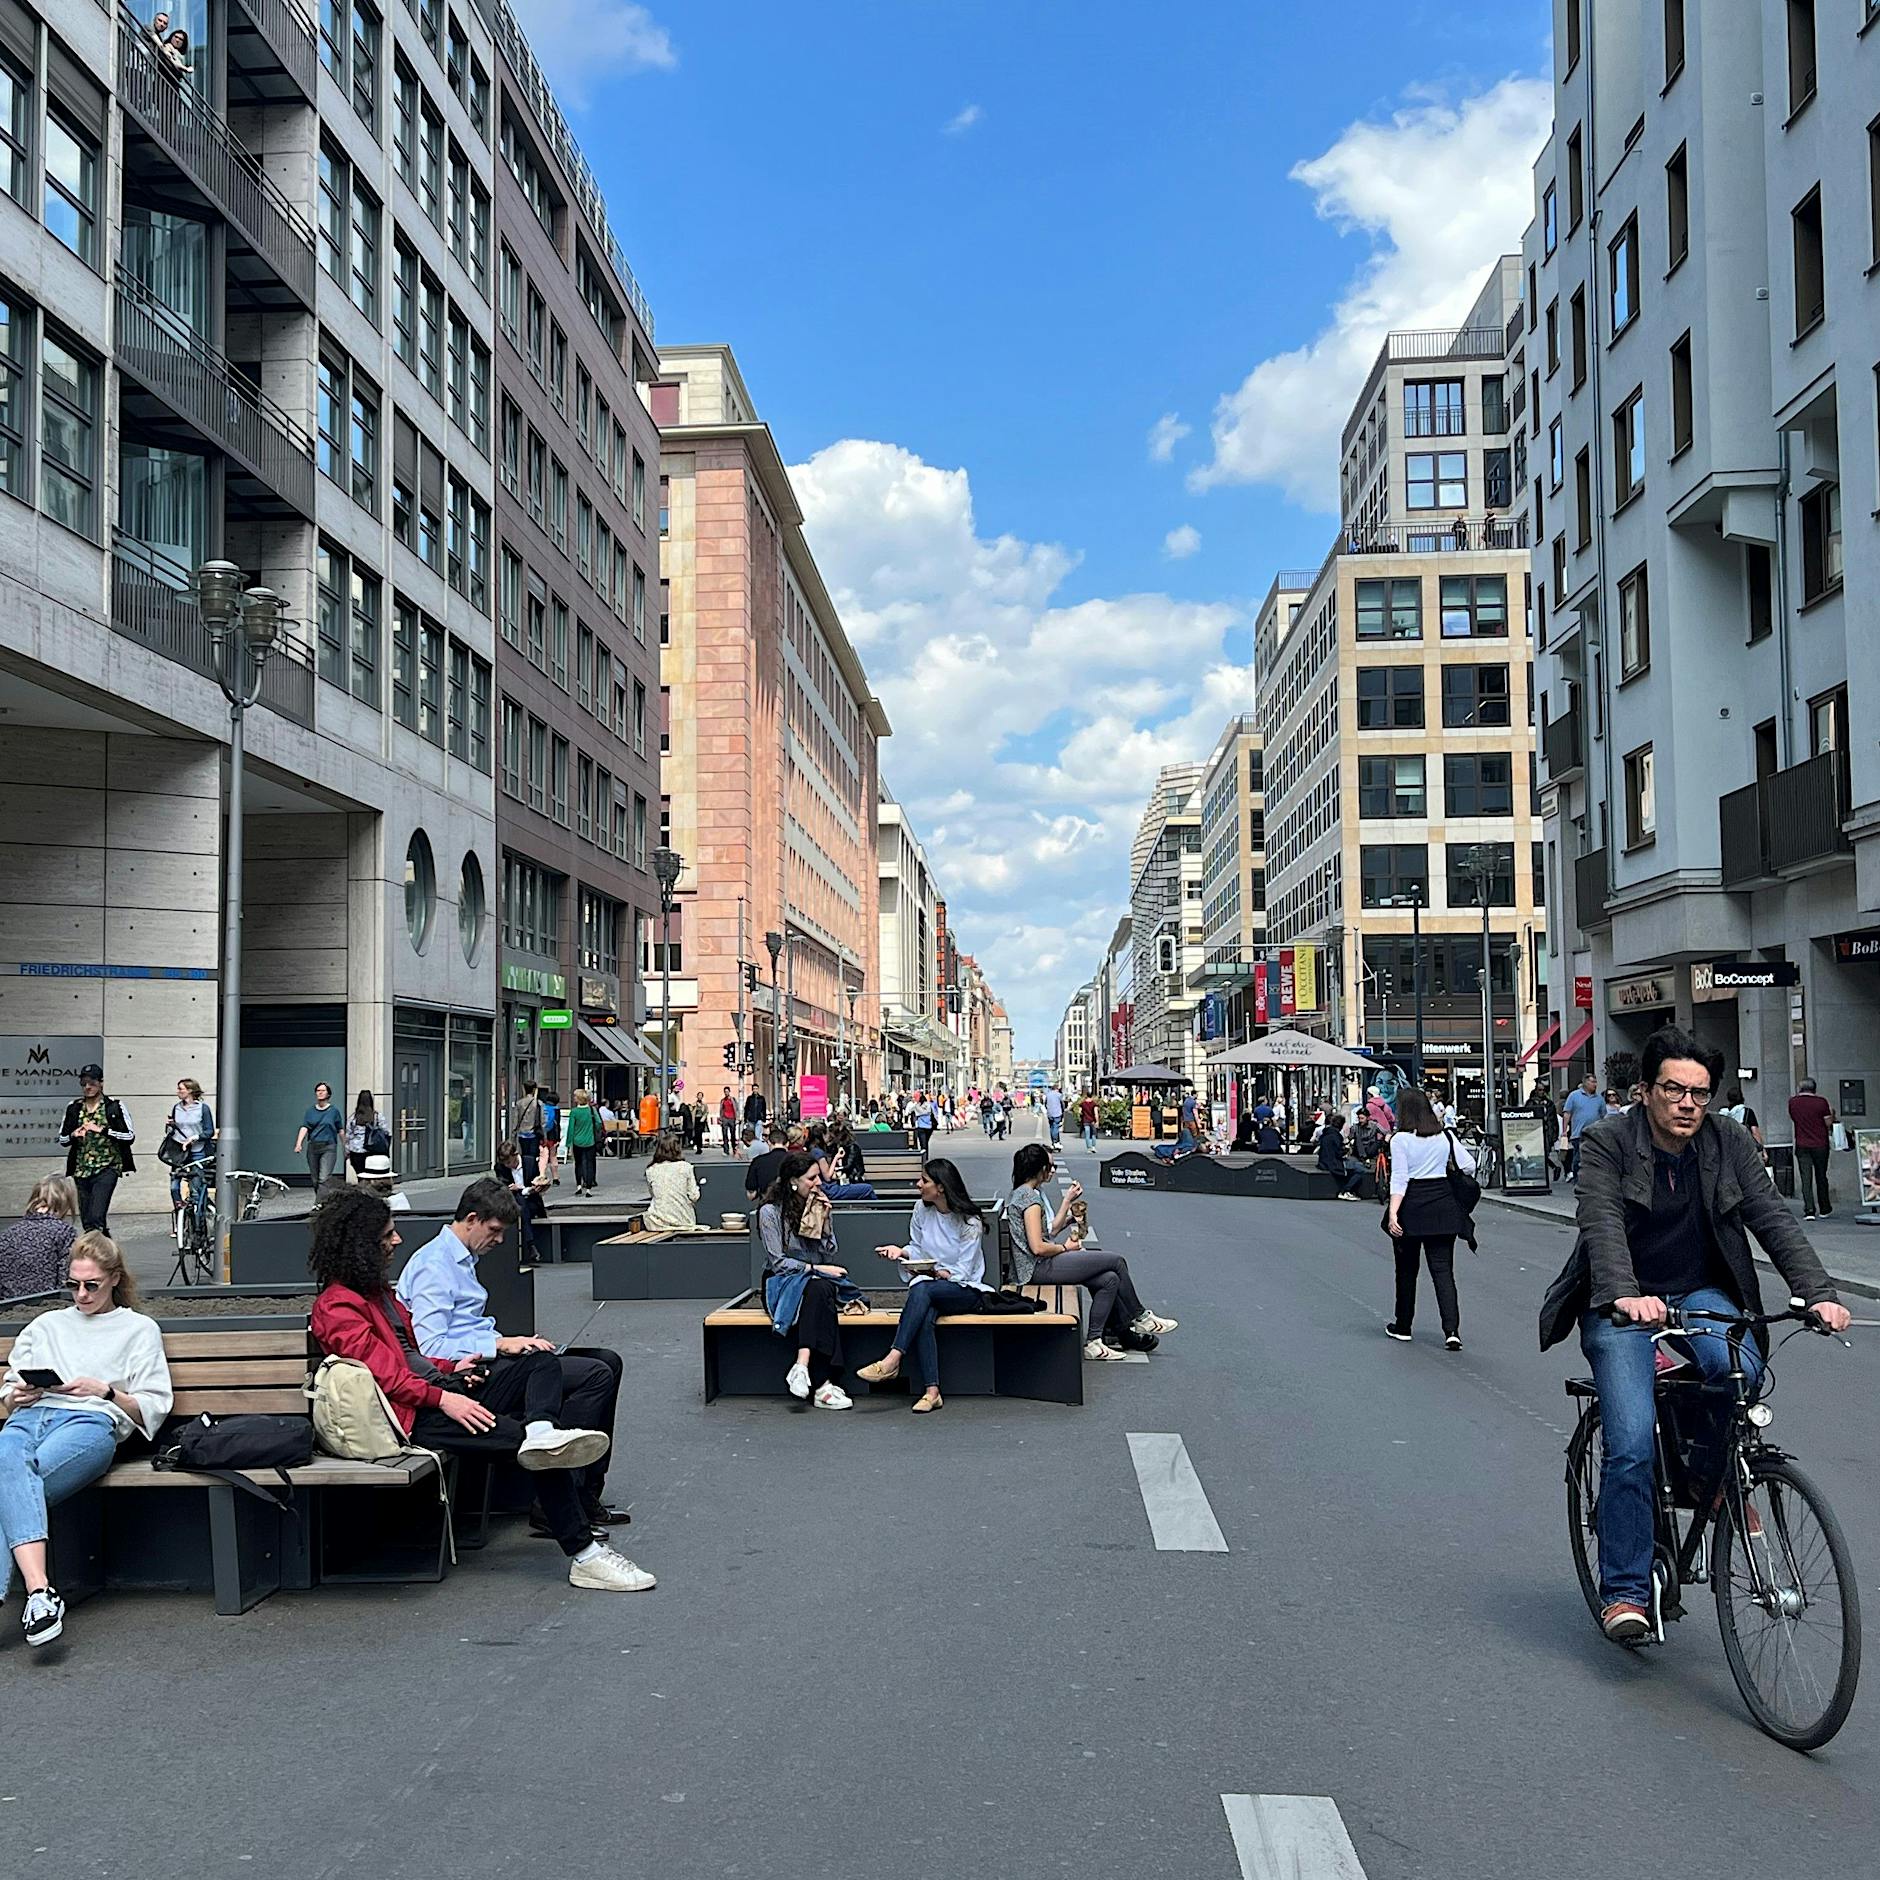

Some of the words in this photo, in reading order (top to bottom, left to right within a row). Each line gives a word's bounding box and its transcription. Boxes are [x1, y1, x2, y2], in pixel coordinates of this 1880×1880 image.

[1851, 940, 1880, 955] BoB
[1281, 965, 1293, 1005] REWE
[1714, 973, 1774, 986] BoConcept
[1422, 1043, 1471, 1053] ittenwerk
[15, 1068, 80, 1077] MANDAL
